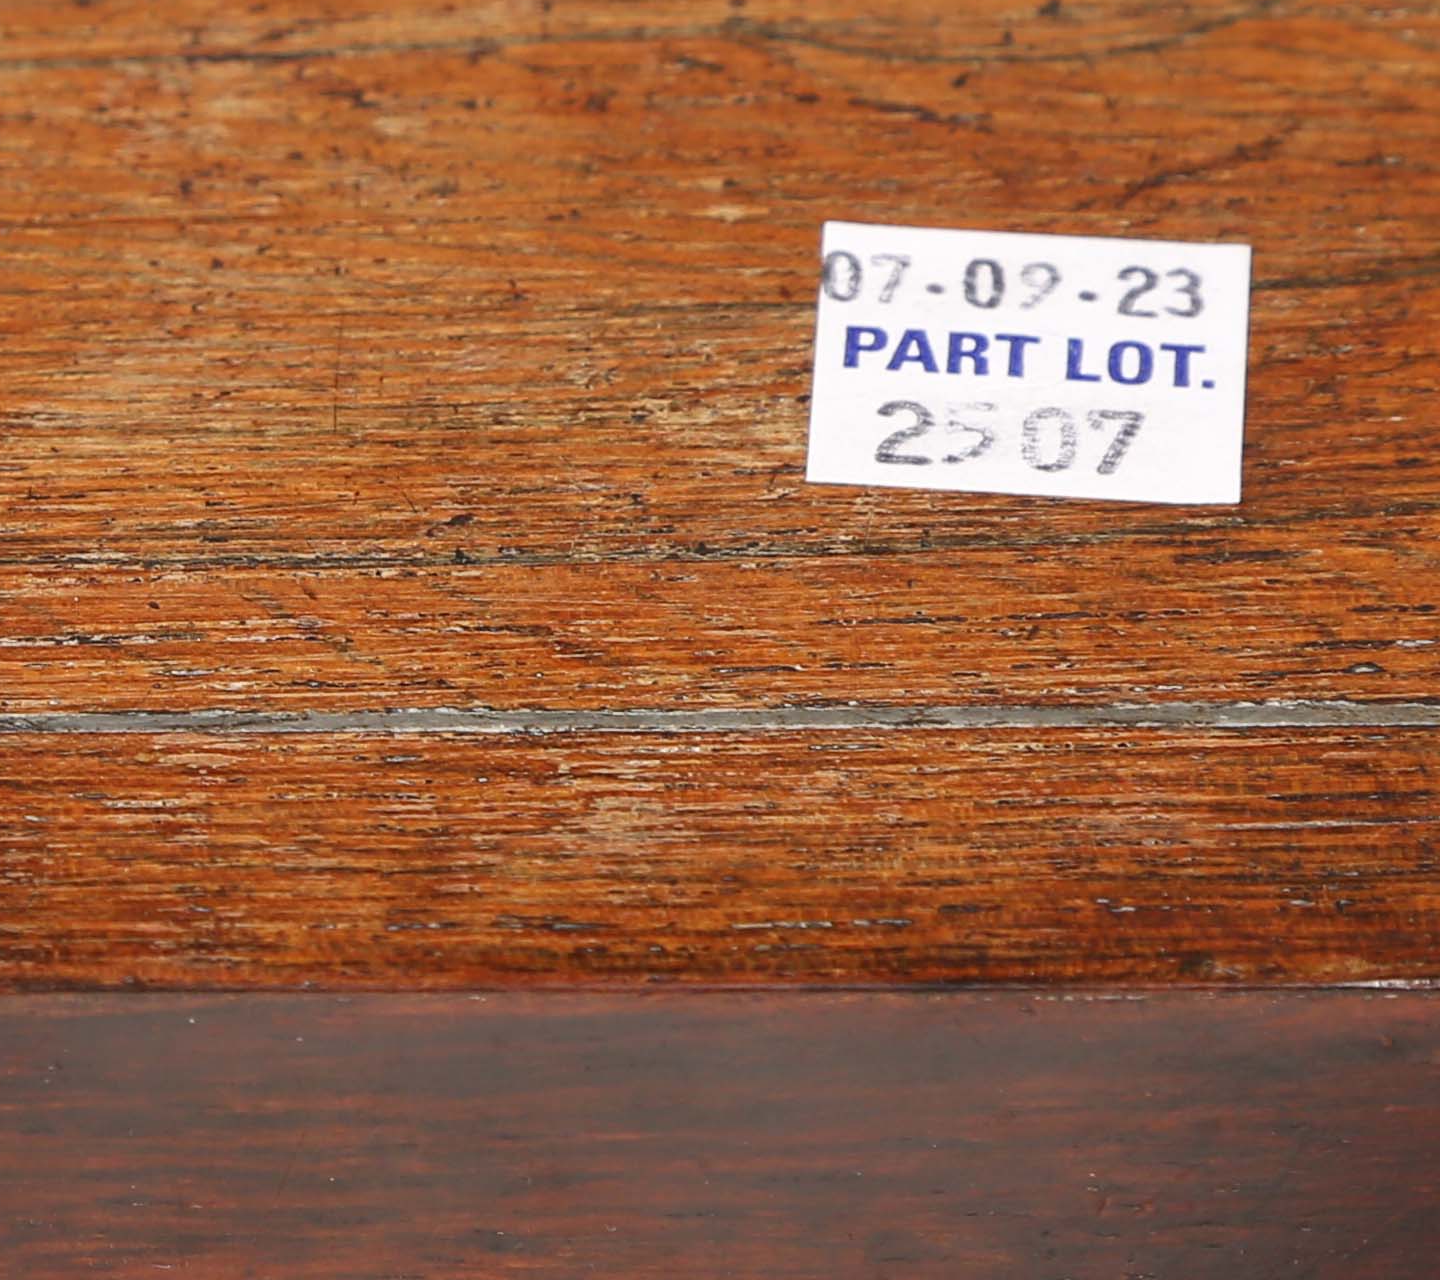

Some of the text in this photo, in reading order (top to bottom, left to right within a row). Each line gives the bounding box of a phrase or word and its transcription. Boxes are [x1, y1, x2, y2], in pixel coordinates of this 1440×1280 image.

[842, 325, 1215, 389] PART LOT.
[874, 399, 1146, 476] 2507
